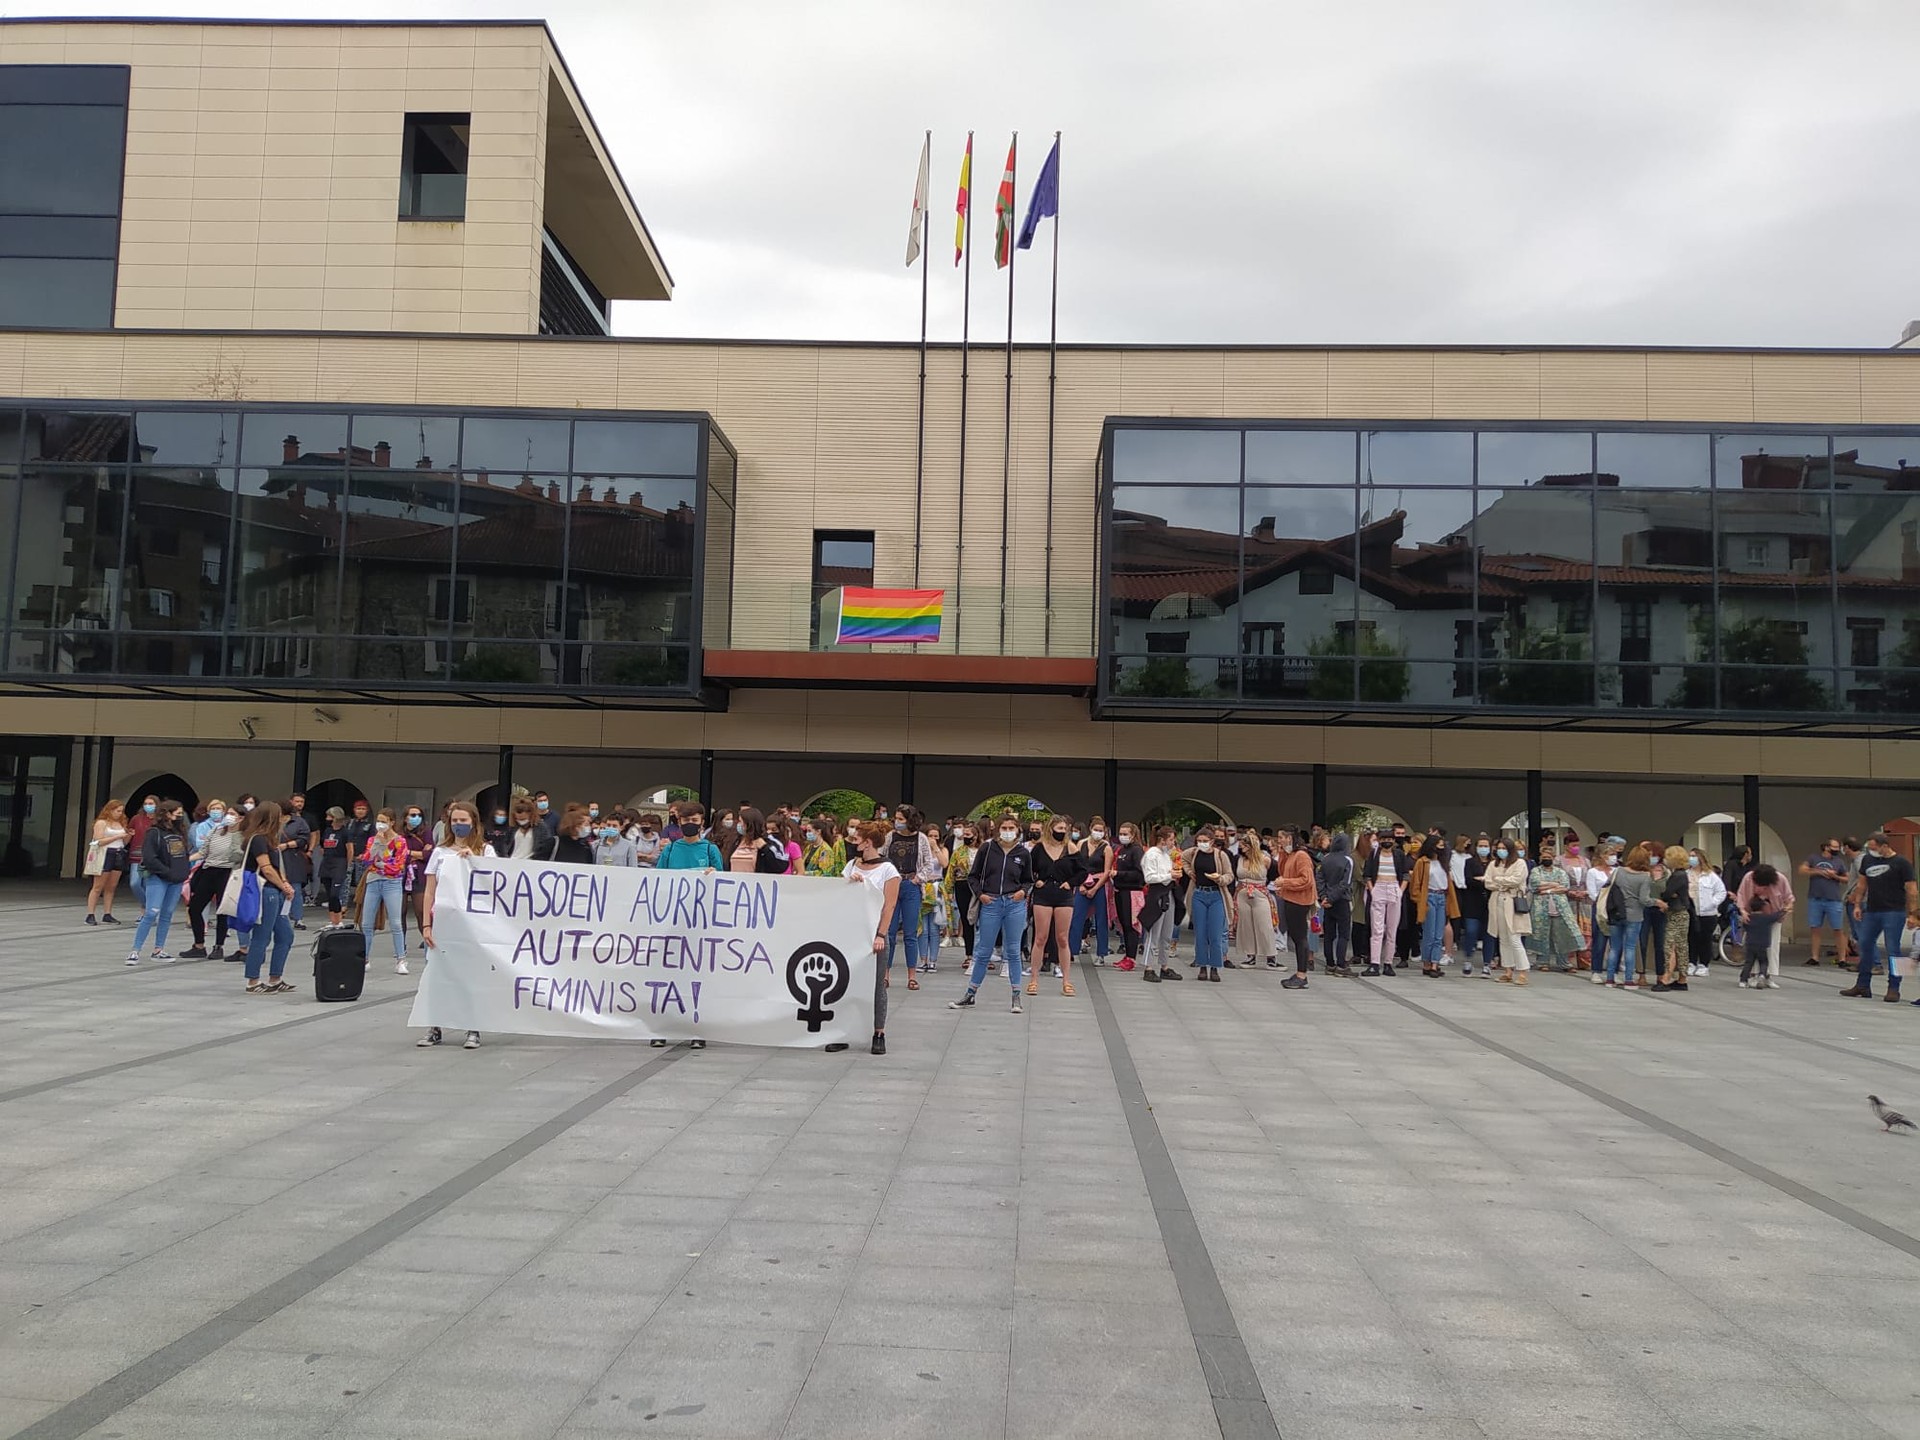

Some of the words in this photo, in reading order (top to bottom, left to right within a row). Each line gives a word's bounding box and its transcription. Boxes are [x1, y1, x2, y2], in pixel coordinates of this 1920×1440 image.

[466, 870, 608, 922] ERASOEN
[630, 876, 778, 929] AURREAN
[511, 928, 774, 974] AUTODEFENTSA
[514, 977, 701, 1023] FEMINISTA!
